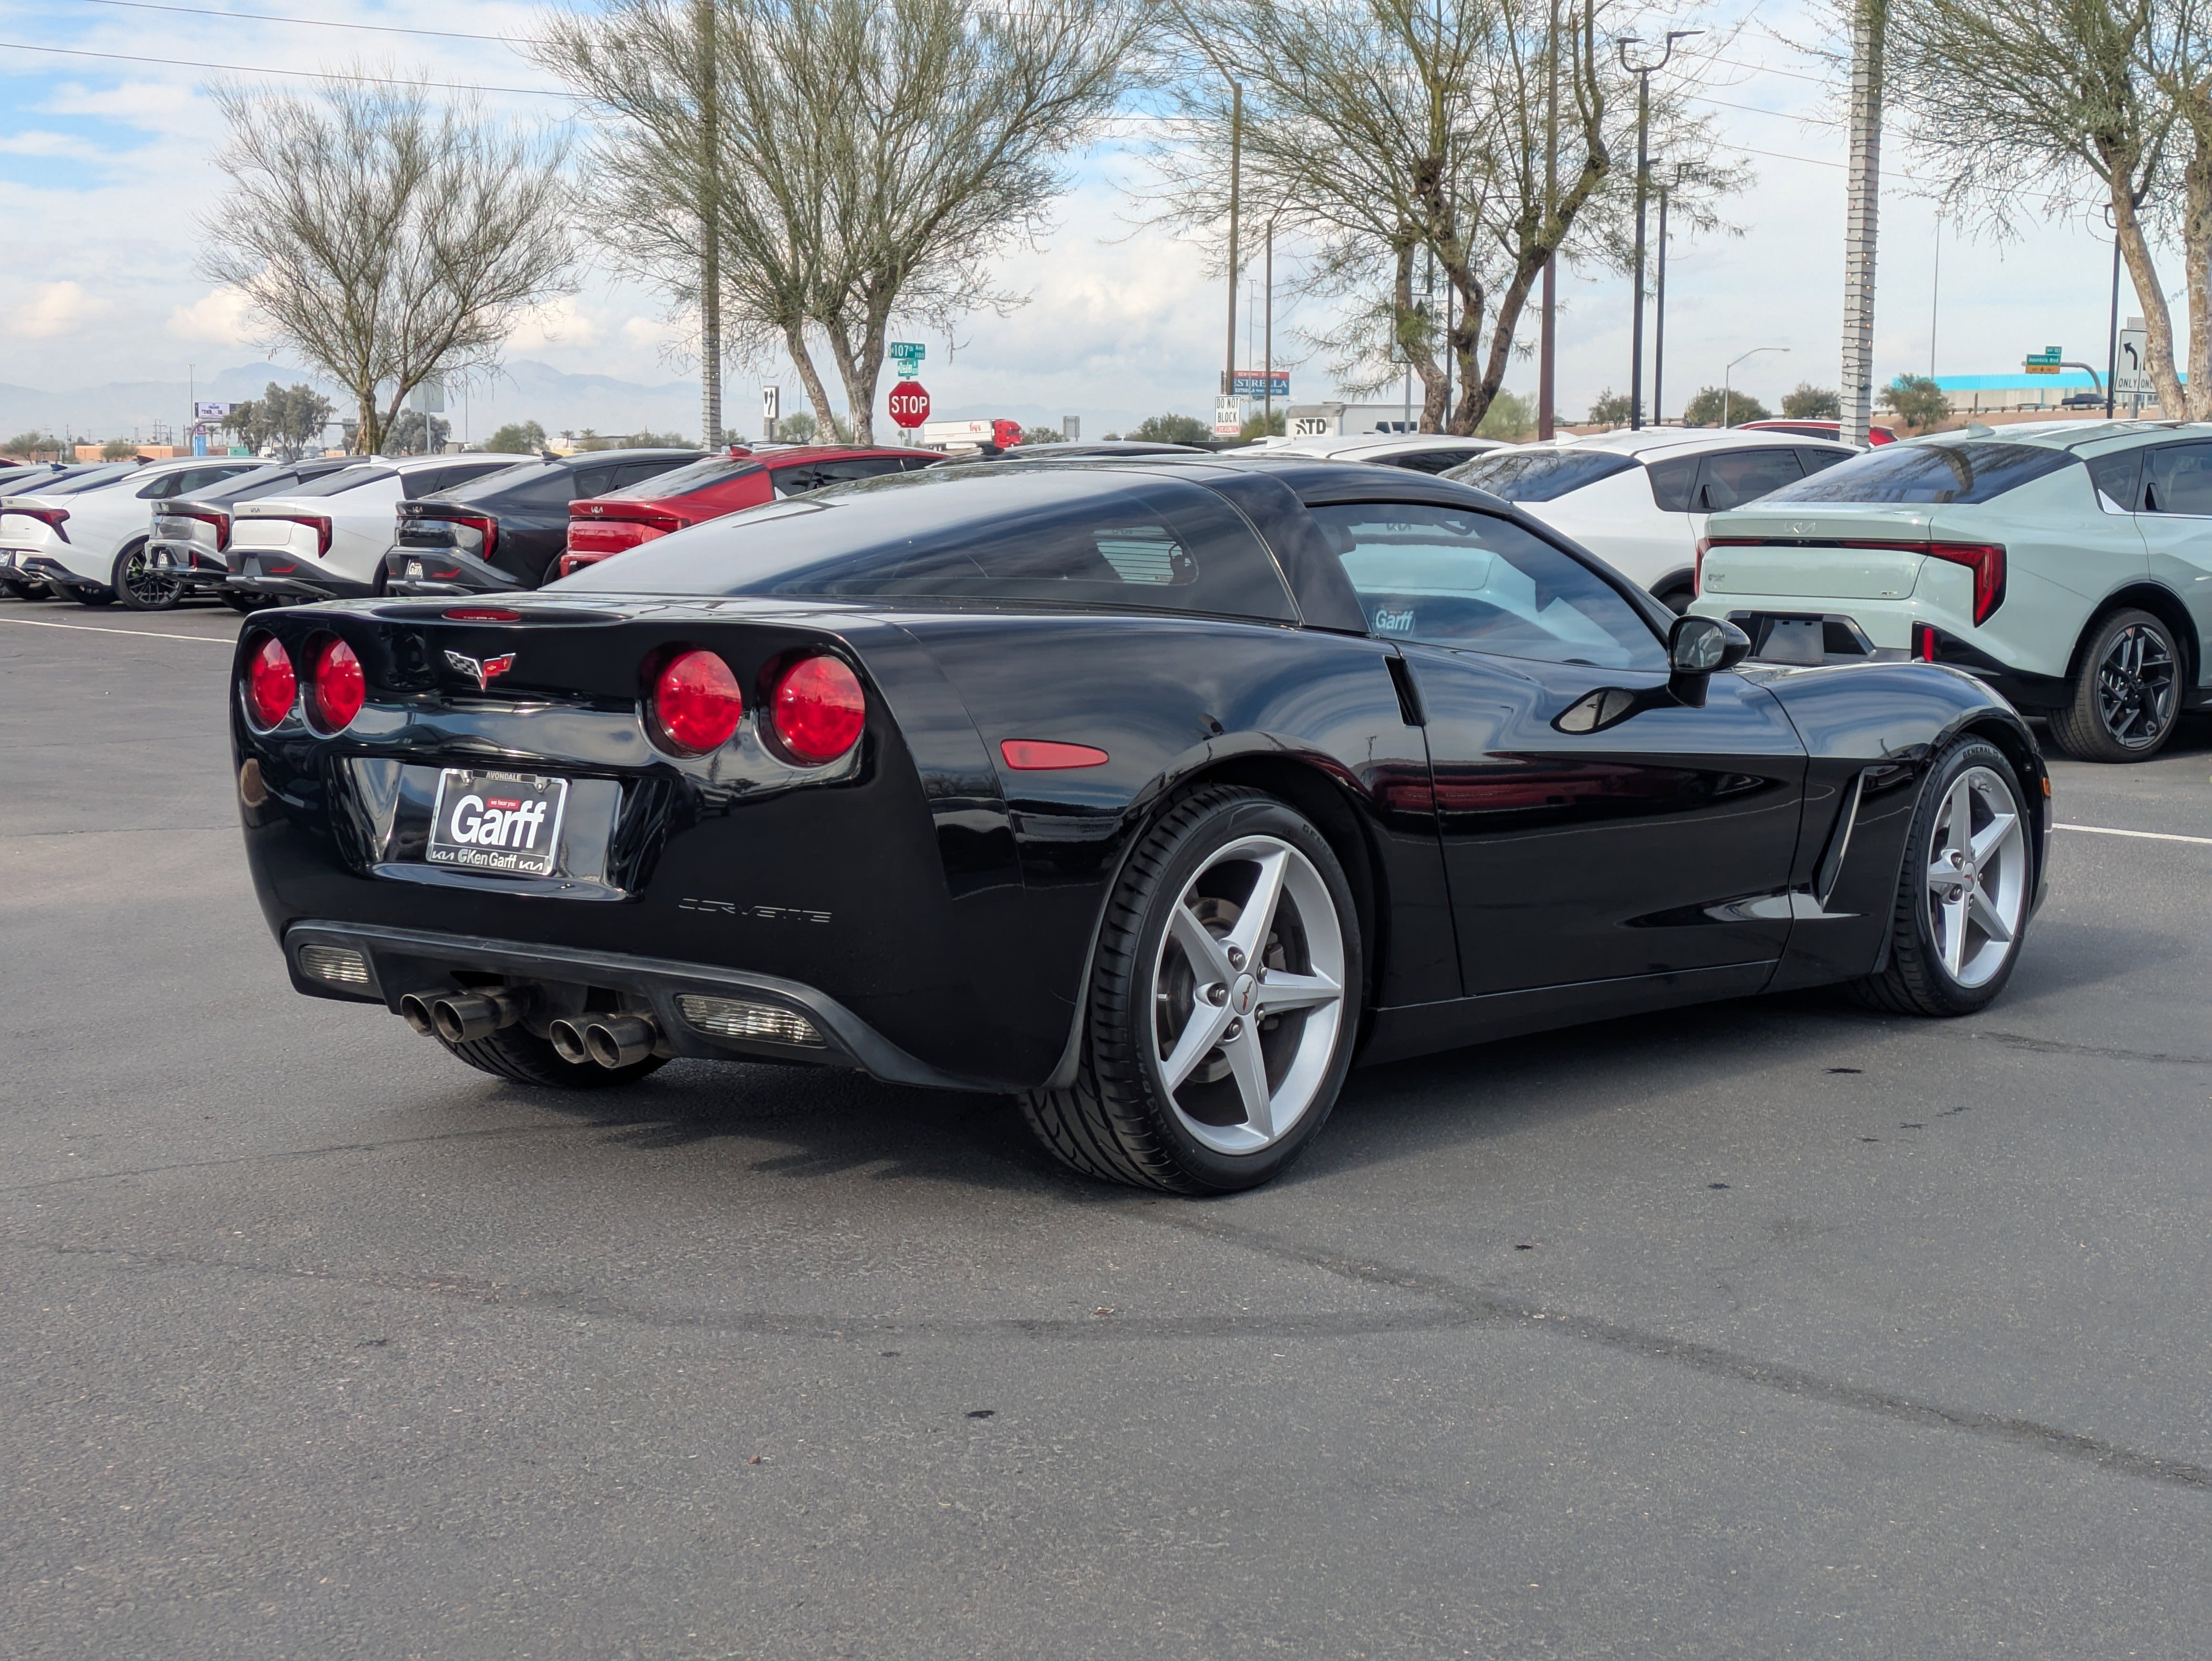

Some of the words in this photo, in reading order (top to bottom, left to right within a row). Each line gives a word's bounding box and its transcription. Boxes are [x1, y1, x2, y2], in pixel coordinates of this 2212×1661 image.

[1234, 378, 1287, 388] STRELA
[2118, 378, 2137, 388] ONLY
[2141, 379, 2152, 388] ONL
[891, 396, 928, 414] STOP
[1217, 398, 1224, 409] DO
[1227, 398, 1238, 408] NOT
[1218, 412, 1237, 422] BLOCK
[1375, 610, 1414, 631] Garff
[1962, 747, 1992, 759] GENERAL
[486, 772, 522, 781] AVONDALE
[451, 795, 547, 849] Garff
[489, 852, 517, 869] Garff
[678, 898, 832, 922] CORVETTE
